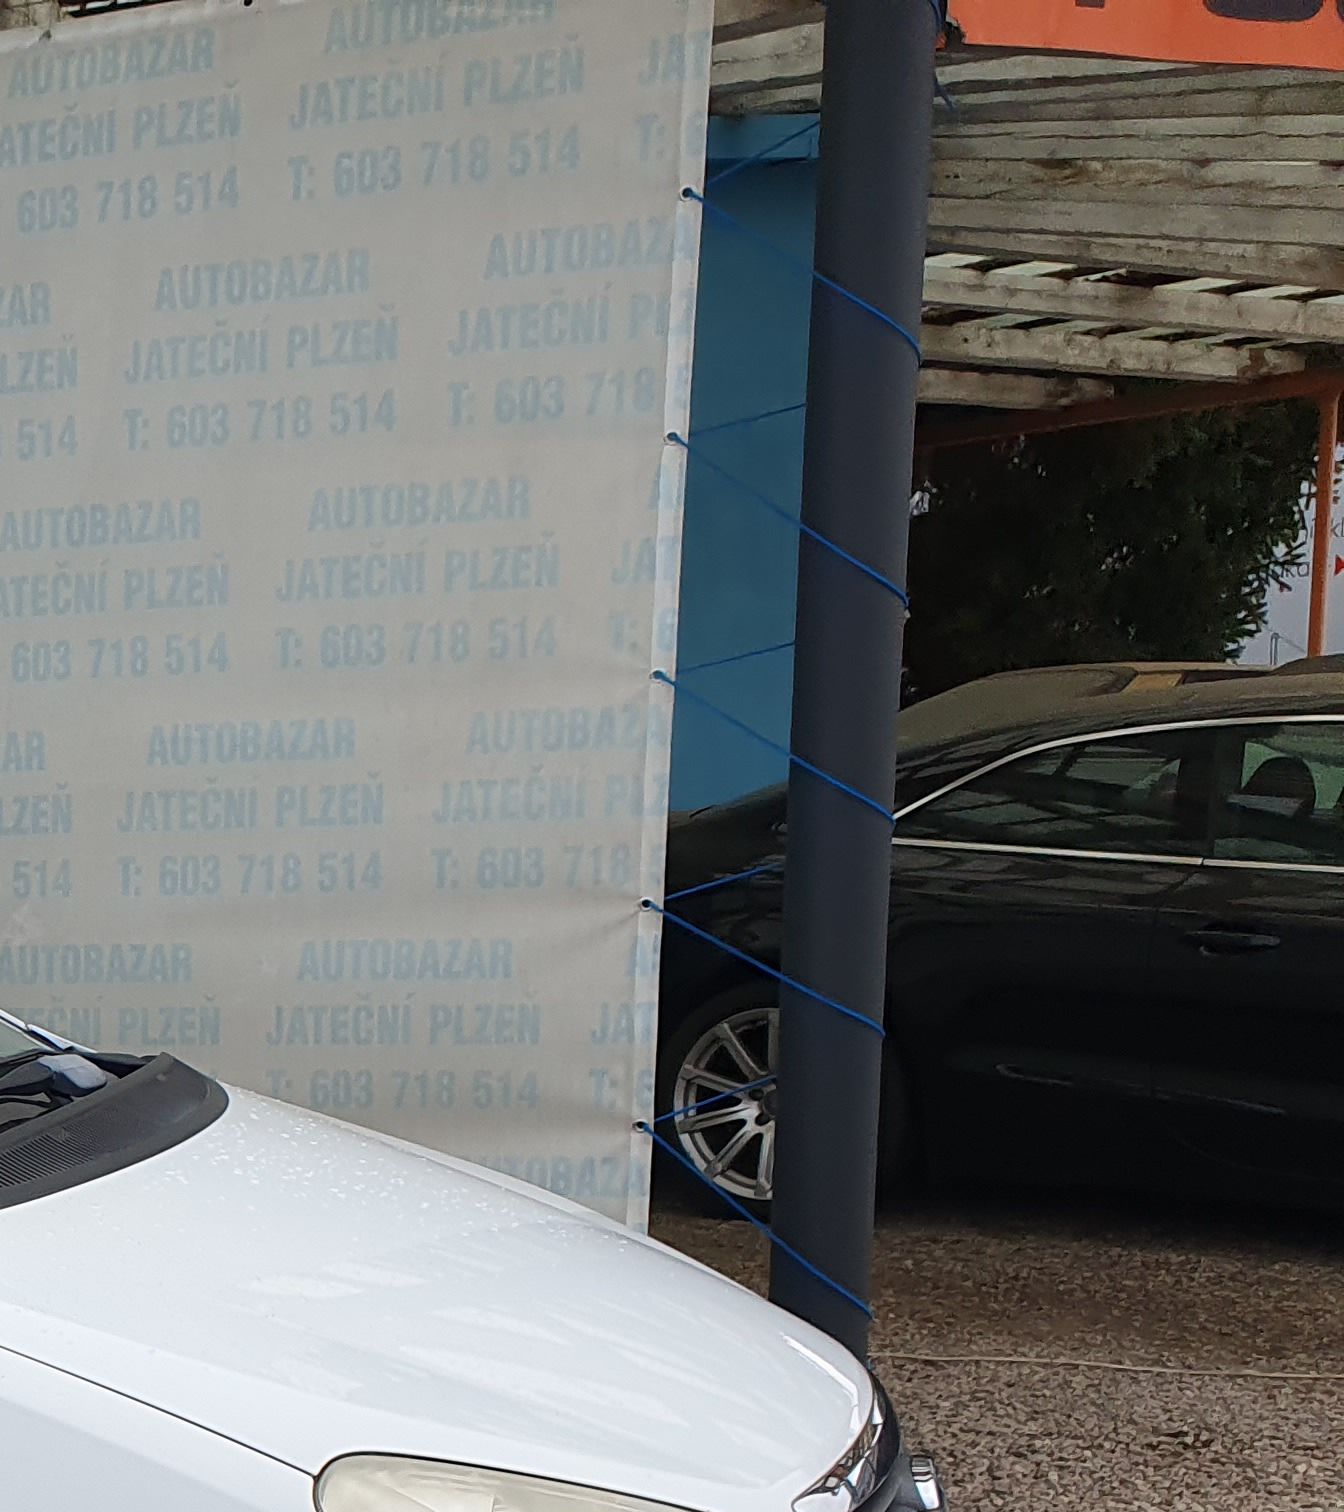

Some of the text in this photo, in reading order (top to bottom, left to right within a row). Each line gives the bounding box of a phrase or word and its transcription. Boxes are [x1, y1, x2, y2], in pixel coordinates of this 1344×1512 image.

[7, 27, 217, 100] AUTOBAZAR
[289, 33, 585, 131] JATEČNÍ PLZEŇ
[132, 79, 241, 149] PLZEŇ
[334, 126, 580, 198] 603 718 514
[17, 165, 239, 234] 603 718 514
[154, 248, 369, 312] AUTOBAZAR
[123, 302, 399, 386] JATEČNÍ PLZEŇ
[449, 282, 612, 355] JATEČNÍ
[123, 391, 396, 451] T: 603 718 514
[495, 366, 656, 425] 603 718
[16, 415, 77, 461] 514
[0, 498, 200, 552] AUTOBAZAR
[308, 475, 530, 532] AUTOBAZAR
[123, 552, 230, 610] PLZEŇ
[275, 530, 559, 603] JATEČNÍ PLZEŇ
[11, 632, 230, 683] 603 718 514
[277, 617, 557, 670] T: 603 718 514
[147, 720, 355, 767] AUTOBAZAR
[117, 770, 383, 833] JATEČNÍ PLZEŇ
[431, 763, 592, 825] JATEČNÍ
[13, 860, 72, 903] 514
[119, 851, 383, 896] T: 603 718 514
[476, 849, 545, 890] 603
[296, 940, 512, 987] AUTOBAZAR
[115, 994, 221, 1052] PLZEŇ
[266, 989, 541, 1049] JATEČNÍ PLZEŇ
